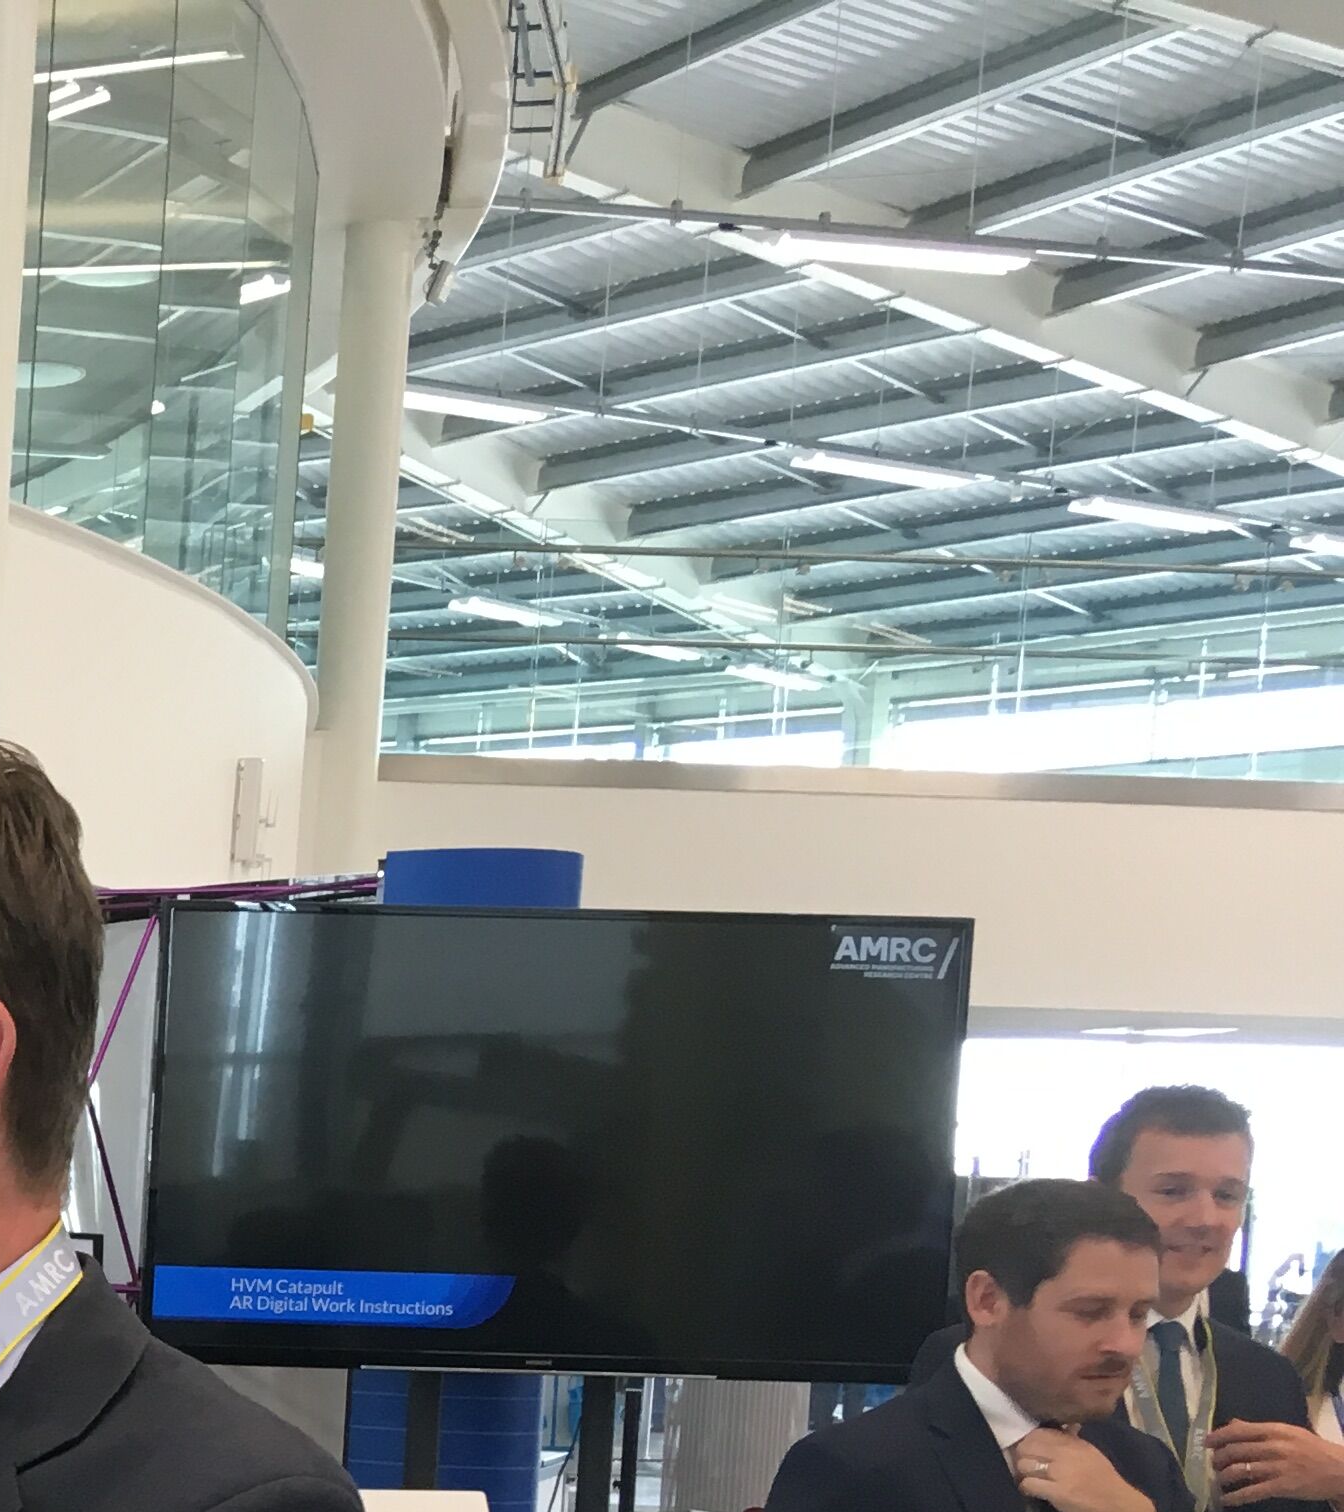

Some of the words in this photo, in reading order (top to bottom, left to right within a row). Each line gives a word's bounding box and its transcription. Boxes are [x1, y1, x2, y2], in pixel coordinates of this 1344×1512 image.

[834, 936, 937, 963] AMRC
[15, 1249, 75, 1317] AMRC
[231, 1278, 272, 1293] HVM
[276, 1279, 344, 1295] Catapult
[229, 1296, 252, 1310] AR
[257, 1296, 307, 1314] Digital
[312, 1298, 354, 1313] Work
[360, 1299, 454, 1316] Instructions
